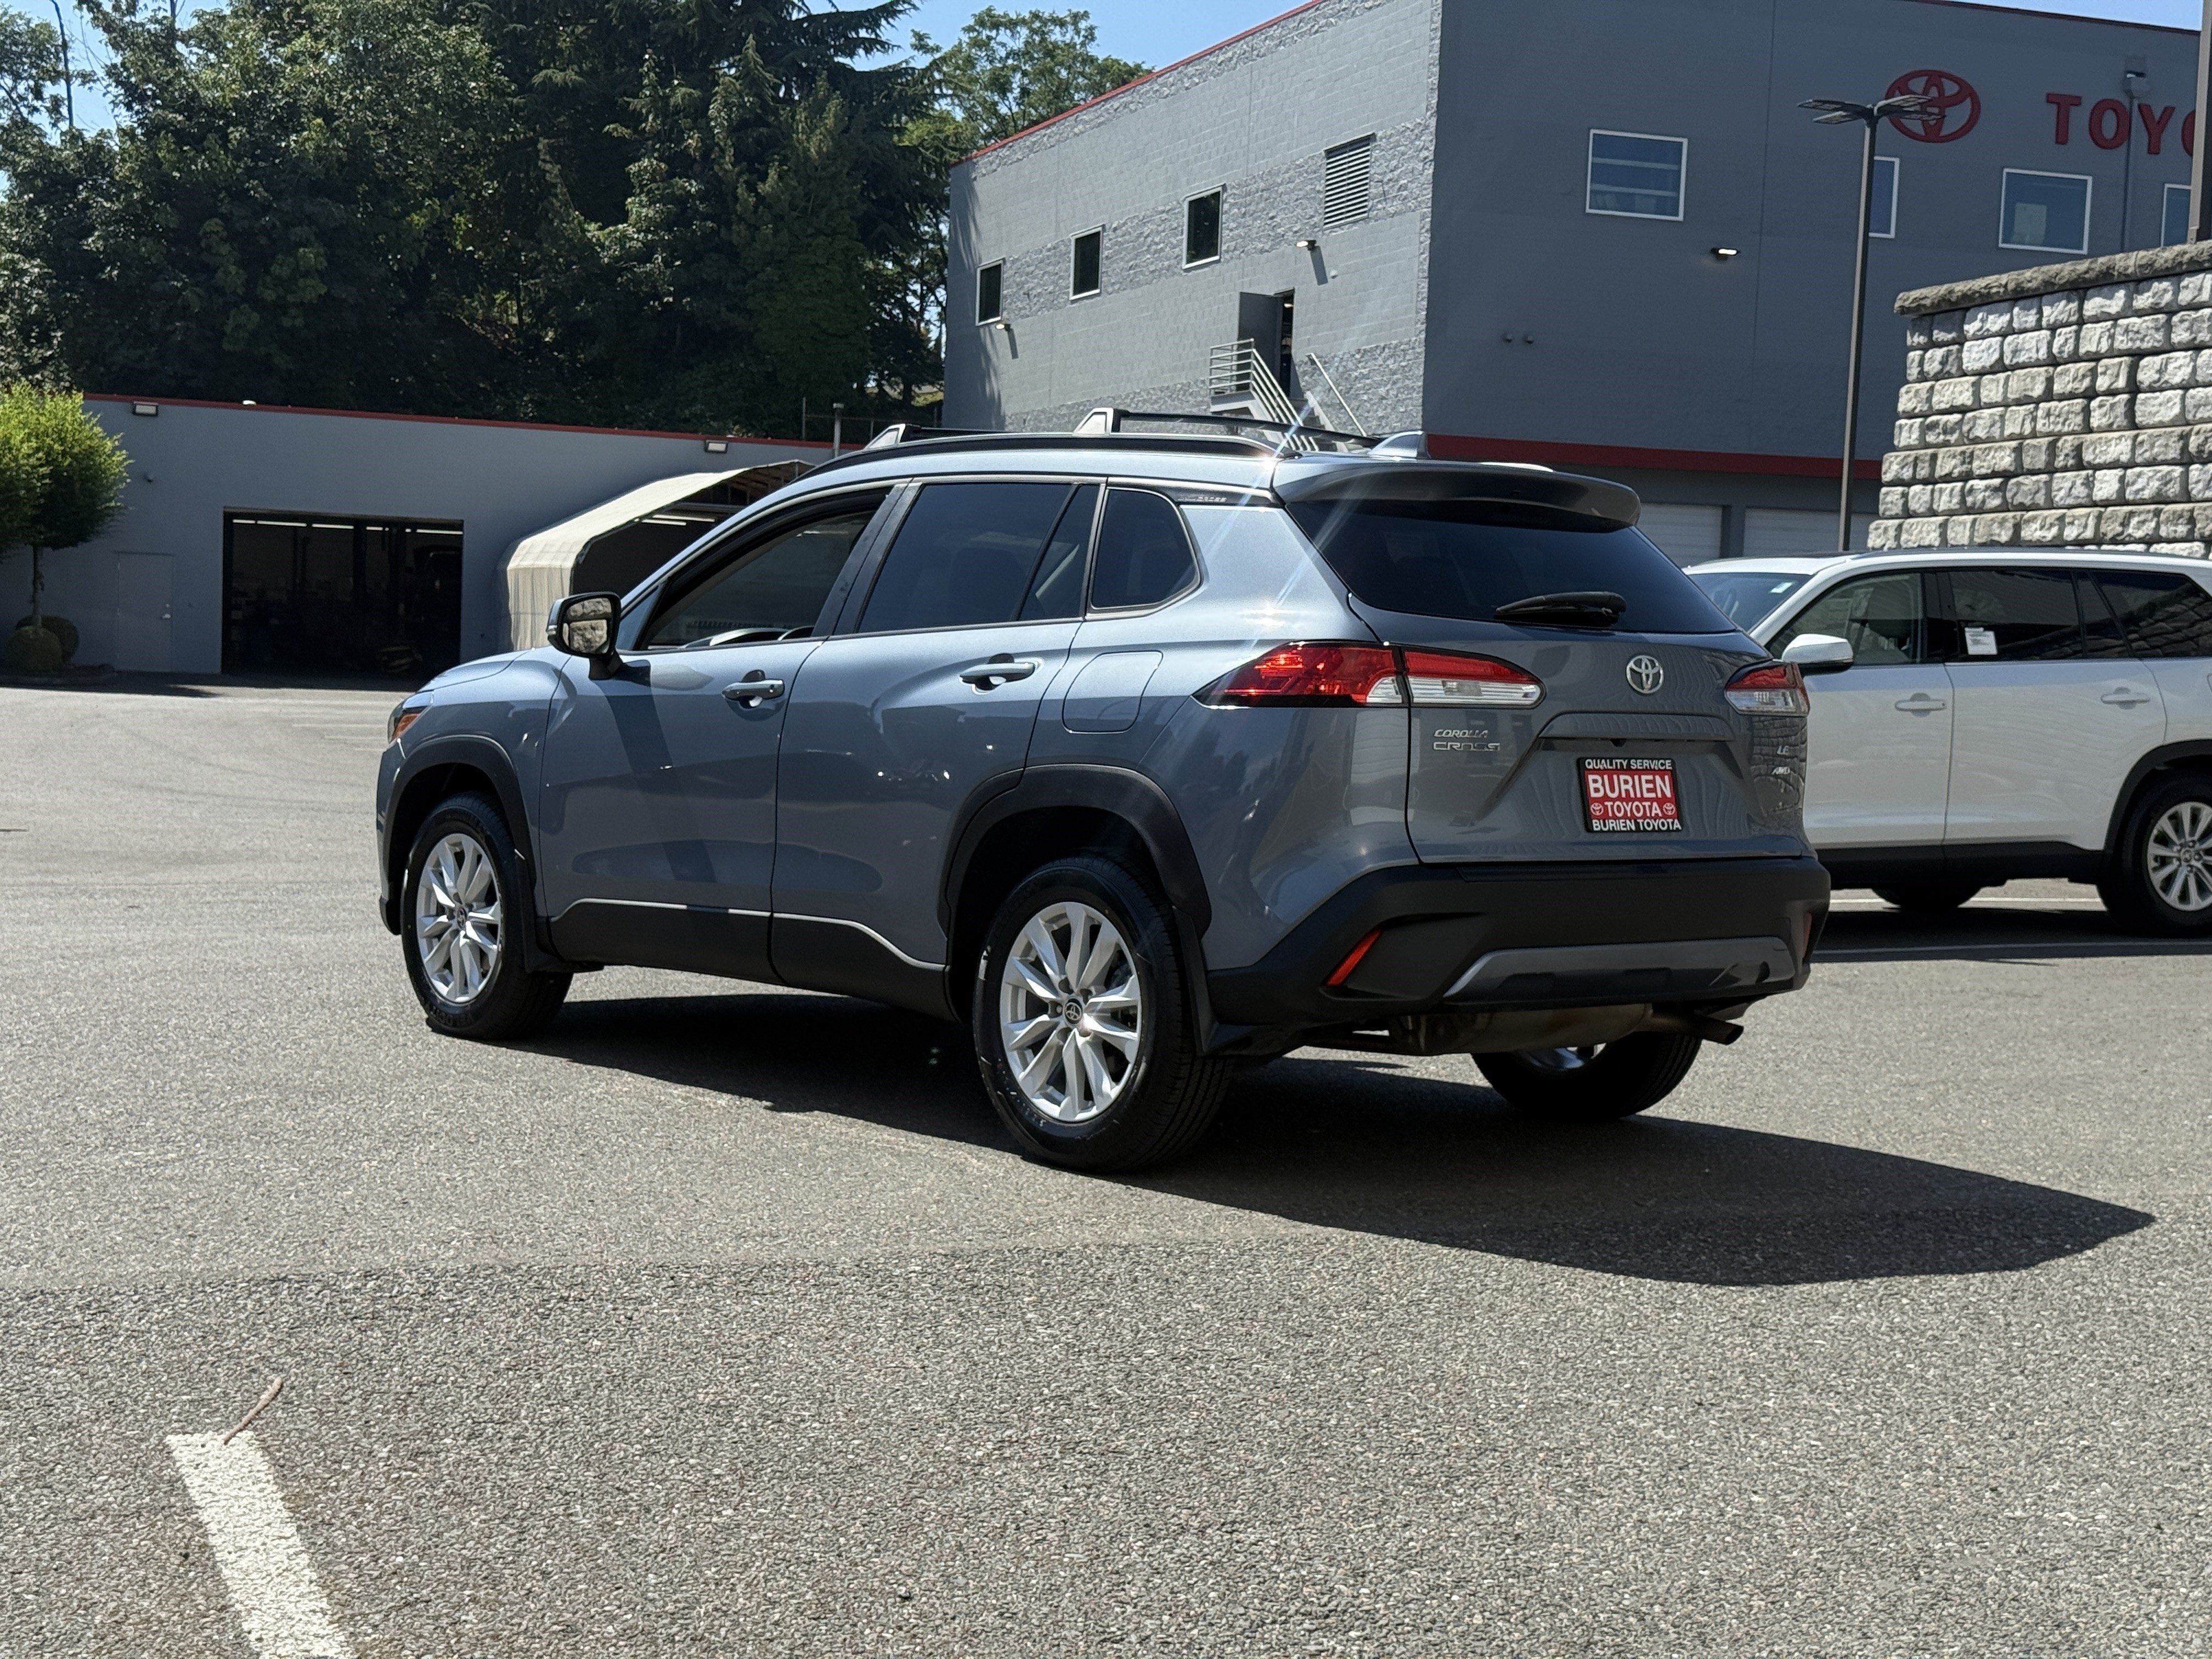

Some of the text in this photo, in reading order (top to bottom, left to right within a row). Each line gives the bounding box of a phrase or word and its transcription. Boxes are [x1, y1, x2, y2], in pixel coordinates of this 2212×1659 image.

[1433, 742, 1500, 752] CROSS
[1585, 759, 1673, 770] QUALITY SERVICE
[1588, 774, 1672, 799] BURIEN
[1604, 801, 1662, 817] TOYOTA
[1593, 819, 1682, 831] BURIEN TOYOTA
